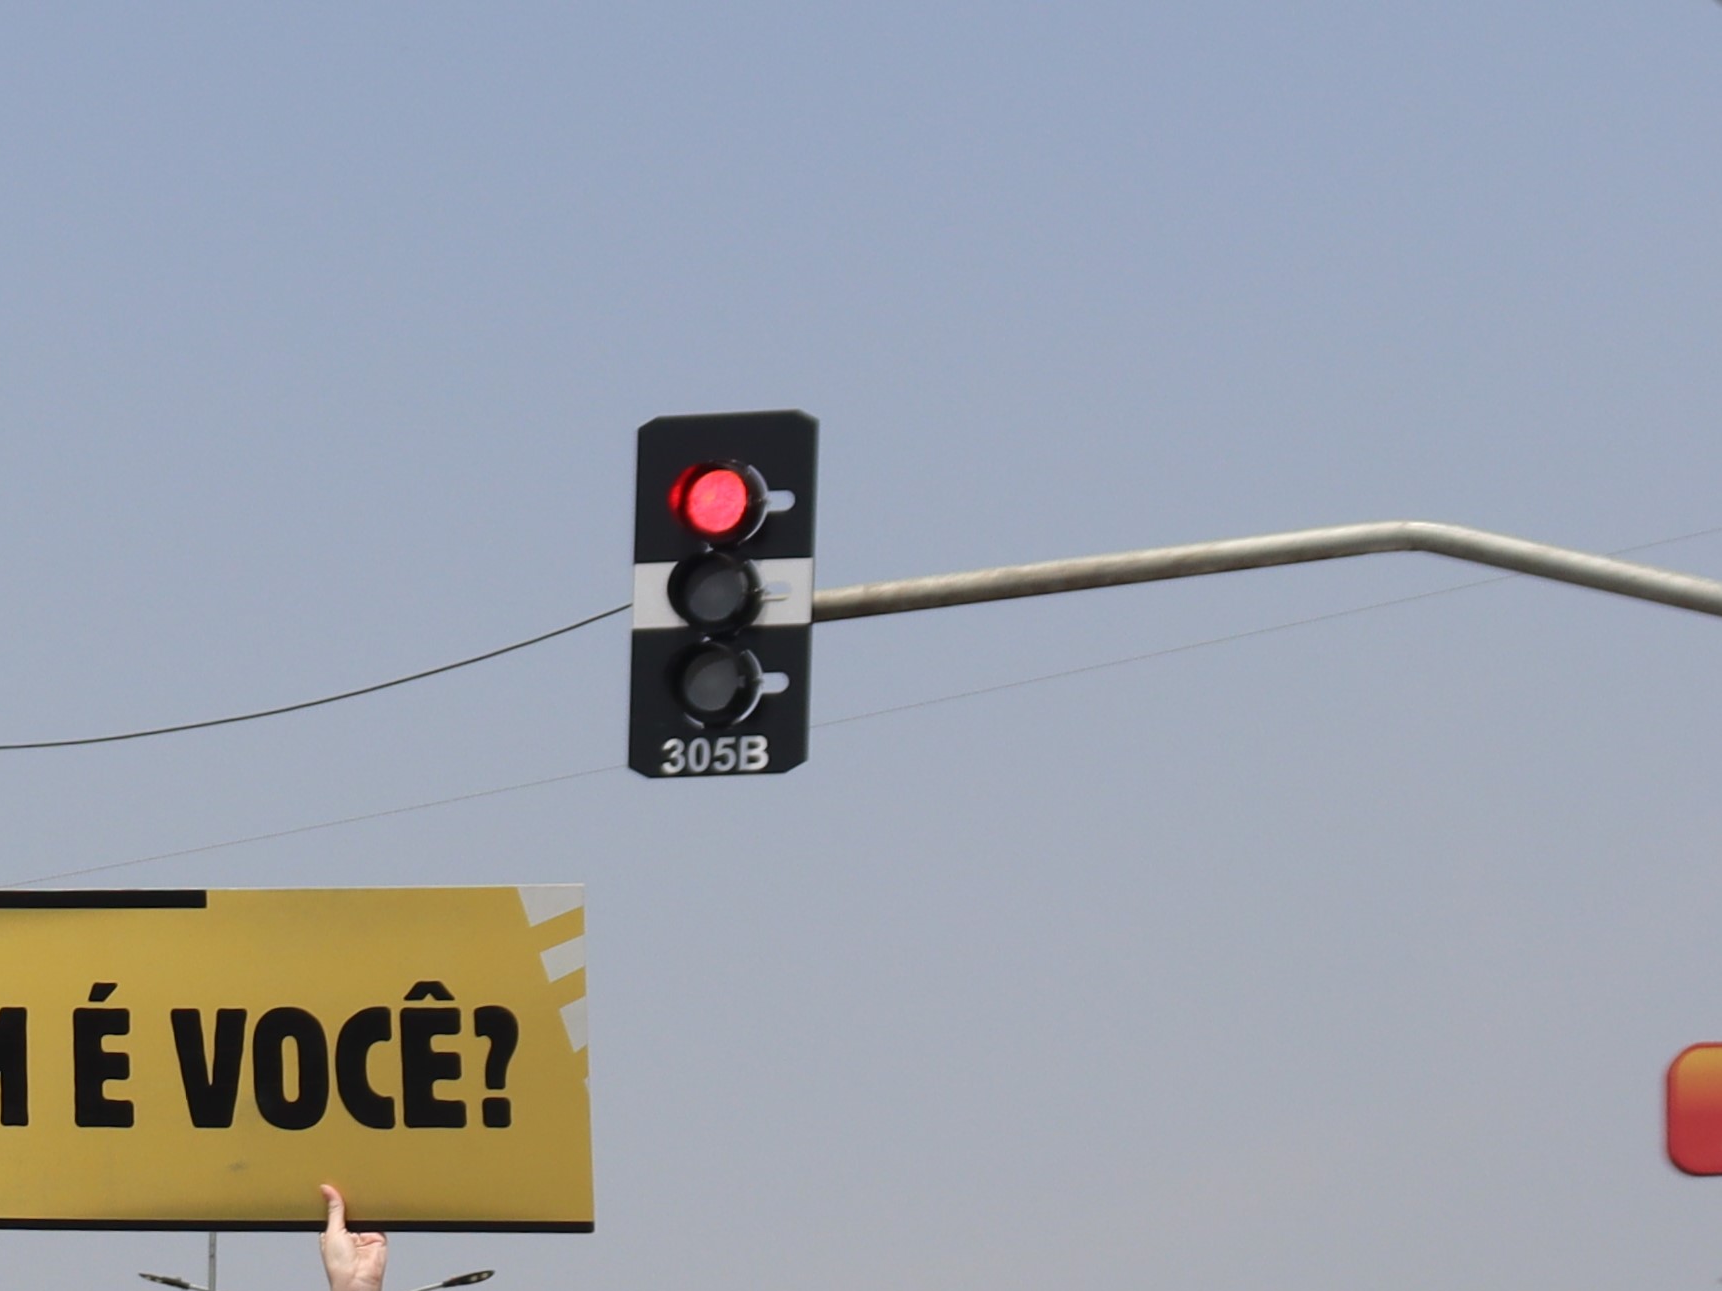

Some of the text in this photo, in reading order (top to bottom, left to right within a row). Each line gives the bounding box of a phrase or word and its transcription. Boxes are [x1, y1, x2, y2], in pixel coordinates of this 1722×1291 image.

[662, 735, 769, 774] 305B
[73, 982, 135, 1129] É
[171, 980, 519, 1131] VOCÊ?
